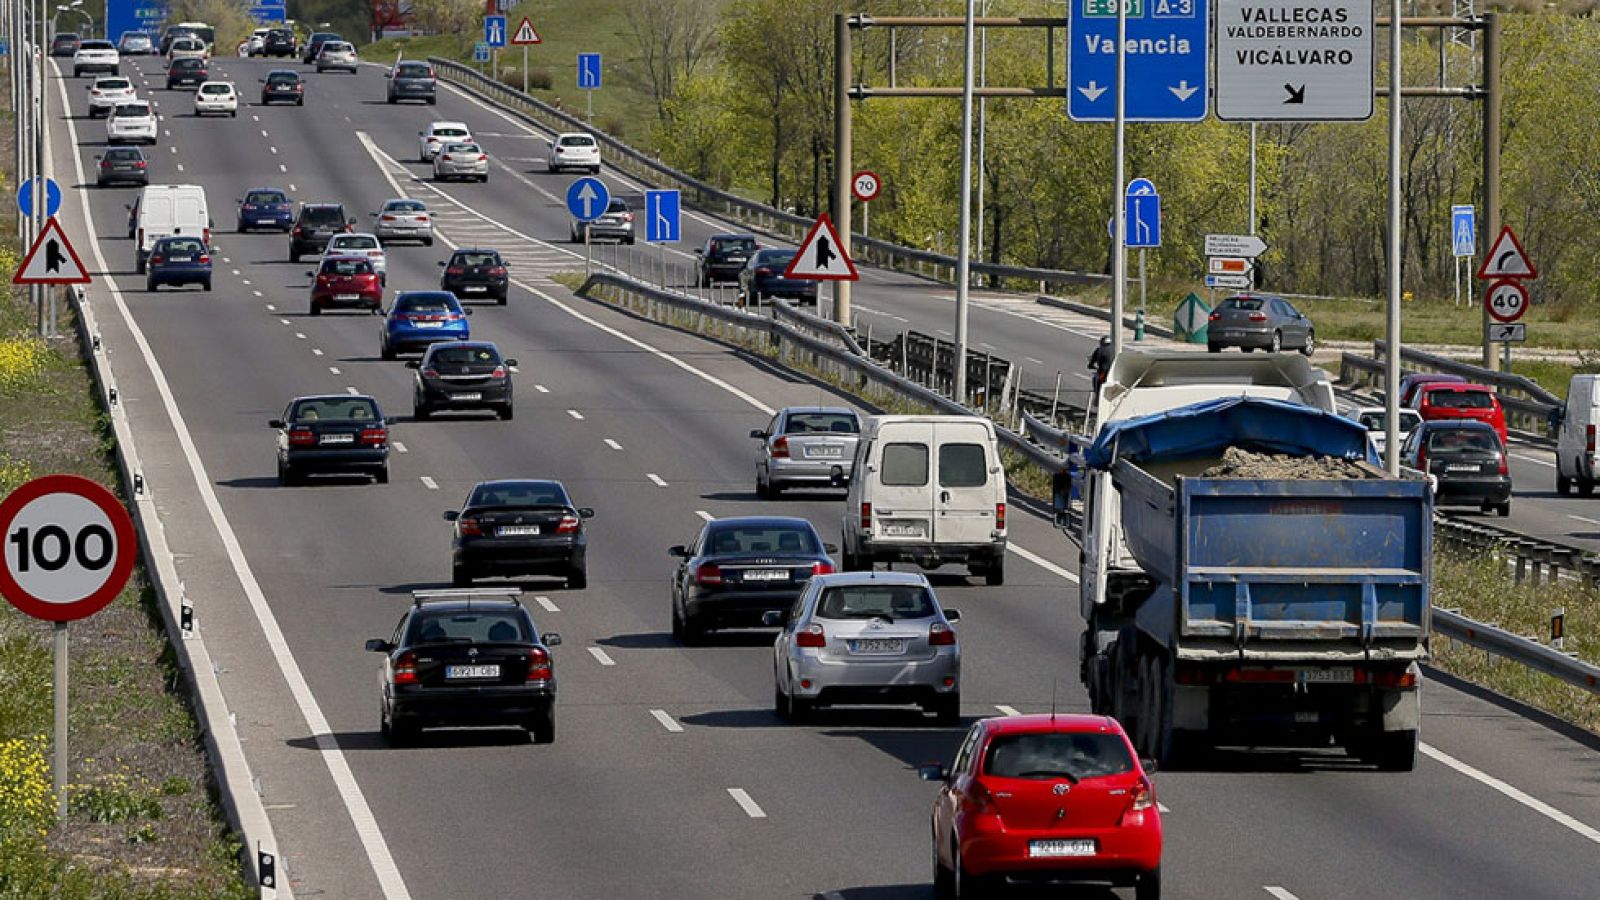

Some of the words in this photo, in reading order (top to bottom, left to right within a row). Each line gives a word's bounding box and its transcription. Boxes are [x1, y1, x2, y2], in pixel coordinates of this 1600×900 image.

[1156, 0, 1186, 14] A-3
[1241, 8, 1348, 23] VALLECAS
[1227, 26, 1363, 38] VALDEBERNARDO
[1085, 33, 1191, 54] Vaencia
[1236, 45, 1353, 65] VICÁLVARO
[858, 181, 874, 191] 70
[1493, 294, 1519, 307] 40
[10, 524, 113, 572] 100
